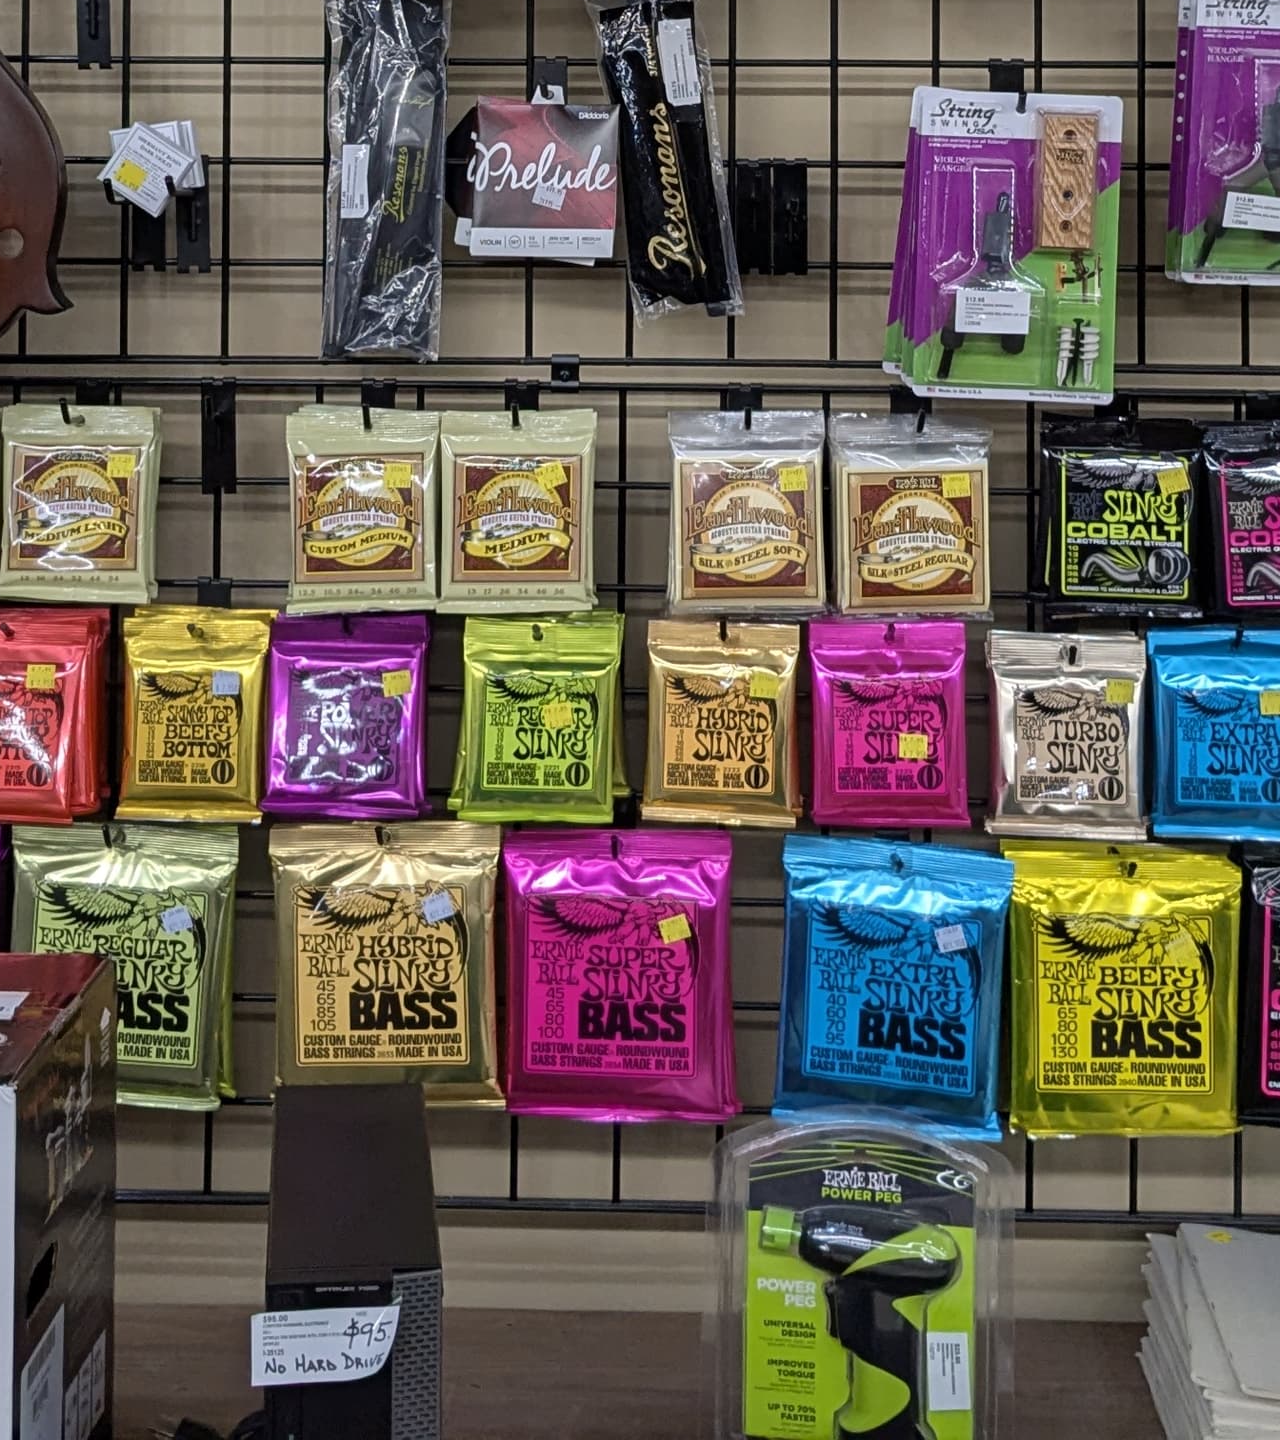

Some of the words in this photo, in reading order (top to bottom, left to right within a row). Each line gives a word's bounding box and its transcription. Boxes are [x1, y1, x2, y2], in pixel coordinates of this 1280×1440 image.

[1206, 10, 1253, 18] SWING
[931, 98, 995, 127] String
[475, 142, 616, 192] Prelude
[382, 146, 408, 224] Resonans
[648, 102, 706, 281] Resonans
[1102, 489, 1178, 522] SLINKY
[310, 541, 357, 554] CUSTOM
[360, 532, 408, 549] MEDIUM
[484, 532, 551, 554] MEDIUM
[1067, 522, 1181, 542] COBALT
[699, 557, 724, 569] SILK
[734, 548, 770, 566] STEEL
[773, 545, 803, 559] SOFT
[867, 566, 888, 578] SILK
[894, 561, 924, 577] STEEL
[924, 553, 969, 569] REGULAR
[697, 708, 771, 732] HYBRID
[867, 710, 941, 732] SUPER
[1049, 721, 1120, 741] TURBO
[163, 724, 231, 741] BEEFY
[162, 741, 233, 758] BOTTOM
[513, 729, 588, 760] SLINKY
[694, 731, 769, 761] SLINKY
[1047, 742, 1121, 776] SLINKY
[93, 934, 192, 962] REGULAR
[358, 935, 453, 958] HYBRID
[587, 945, 685, 970] SUPER
[307, 954, 350, 977] BALL
[352, 959, 453, 992] SLINKY
[536, 961, 579, 985] BALL
[871, 959, 966, 988] EXTRA
[317, 981, 335, 991] 45
[581, 967, 684, 1003] SLINKY
[818, 969, 860, 994] BALL
[1100, 966, 1199, 989] BEEFY
[317, 994, 335, 1005] 65
[862, 978, 965, 1022] SLINKY
[1048, 983, 1091, 1005] BALL
[1094, 987, 1198, 1021] SLINKY
[317, 1007, 336, 1018] 85
[350, 992, 457, 1030] BASS
[579, 1001, 686, 1042] BASS
[311, 1020, 336, 1031] 105
[858, 1008, 966, 1060] BASS
[304, 1035, 346, 1046] CUSTOM
[350, 1035, 382, 1045] GAUGE
[389, 1034, 461, 1044] ROUNDWOUND
[1091, 1020, 1201, 1058] BASS
[304, 1048, 330, 1058] BASS
[333, 1048, 375, 1058] STRINGS
[396, 1047, 424, 1057] MADE
[428, 1047, 438, 1057] IN
[442, 1046, 462, 1056] USA
[822, 1166, 867, 1190] ERNIE
[869, 1171, 901, 1192] BALL
[821, 1187, 872, 1202] POWER
[875, 1190, 902, 1204] PEG
[757, 1277, 817, 1294] POWER
[785, 1293, 816, 1307] PEG
[763, 1319, 816, 1330] UNIVERSAL
[781, 1329, 816, 1339] DESIGN
[295, 1355, 337, 1373] HARD
[341, 1352, 384, 1370] DRIVE
[768, 1358, 815, 1369] IMPROVED
[778, 1369, 815, 1379] TORQUE
[781, 1412, 816, 1423] FASTER
